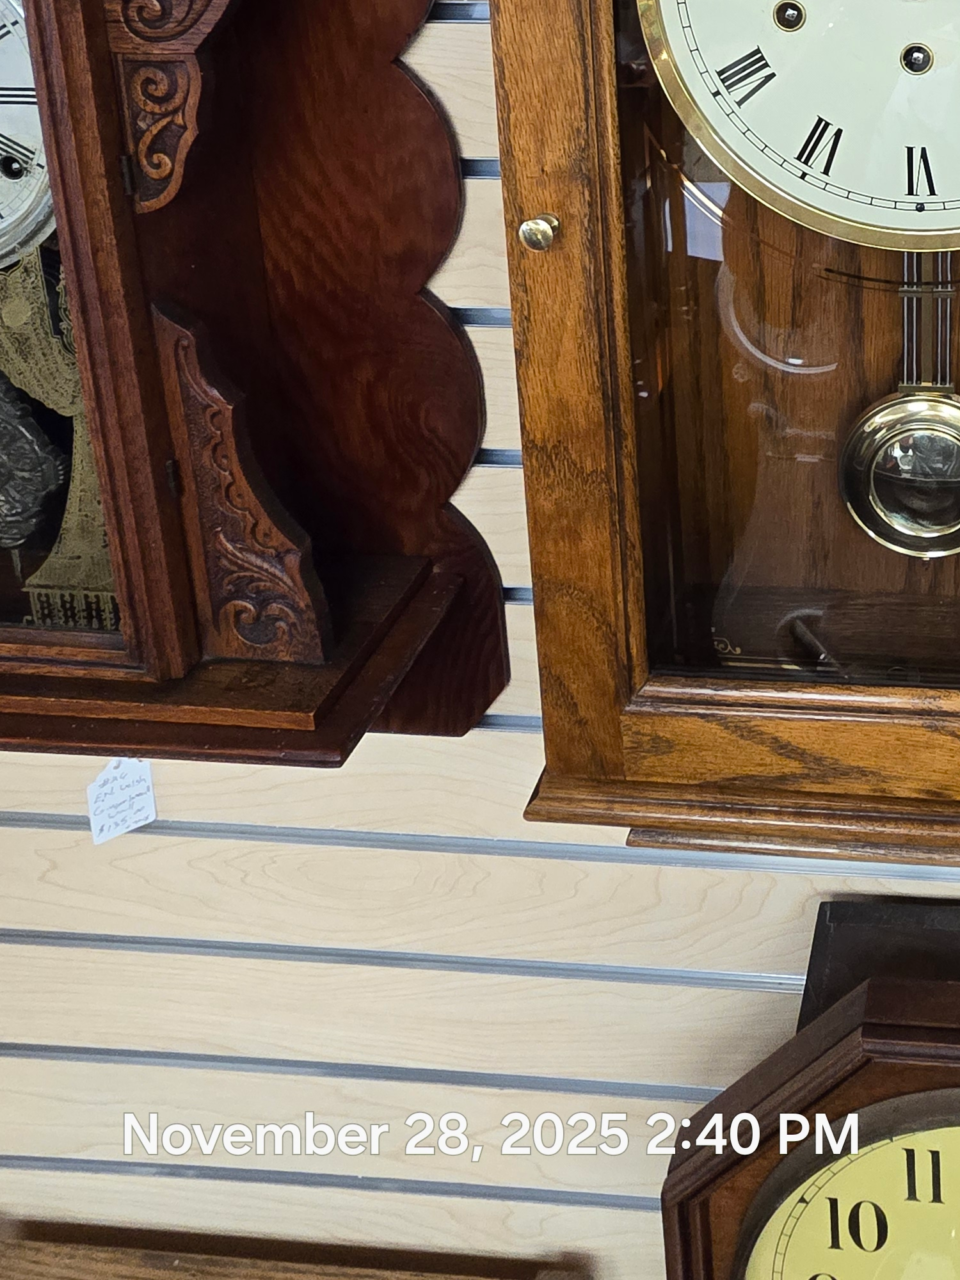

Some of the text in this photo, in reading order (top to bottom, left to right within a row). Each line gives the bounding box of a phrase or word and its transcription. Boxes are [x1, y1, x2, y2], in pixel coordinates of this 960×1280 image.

[715, 45, 777, 109] VIII
[793, 115, 844, 177] VII
[905, 146, 938, 197] VI
[901, 1147, 945, 1204] 11
[825, 1196, 889, 1253] 10
